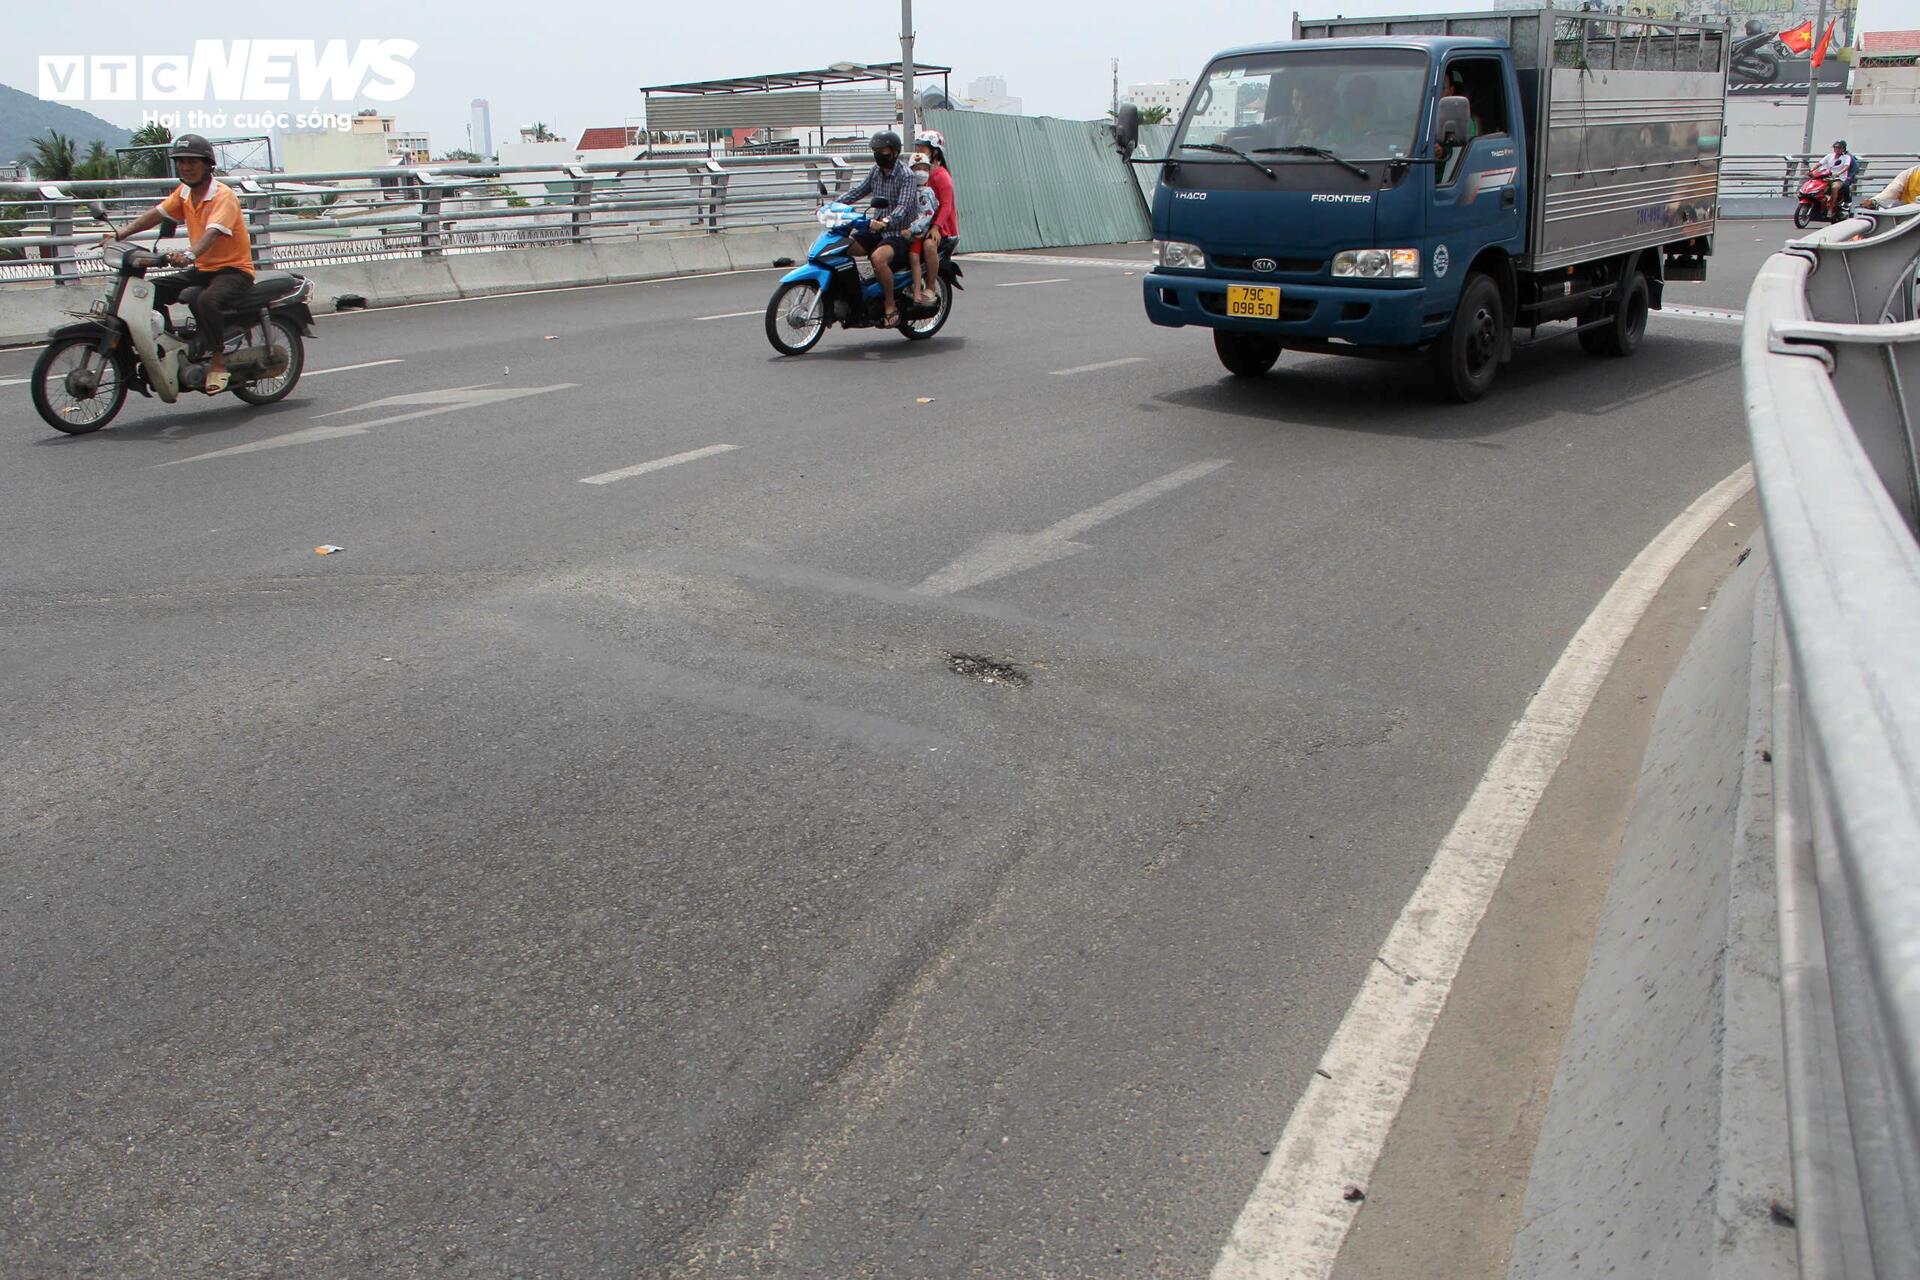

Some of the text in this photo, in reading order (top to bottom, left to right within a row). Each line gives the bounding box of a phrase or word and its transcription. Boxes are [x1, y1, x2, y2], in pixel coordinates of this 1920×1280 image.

[1174, 191, 1208, 201] THACO
[1310, 194, 1372, 204] FRONTIER
[1256, 261, 1273, 270] KIA
[1242, 287, 1265, 301] 79C
[1232, 301, 1273, 316] 098.50
